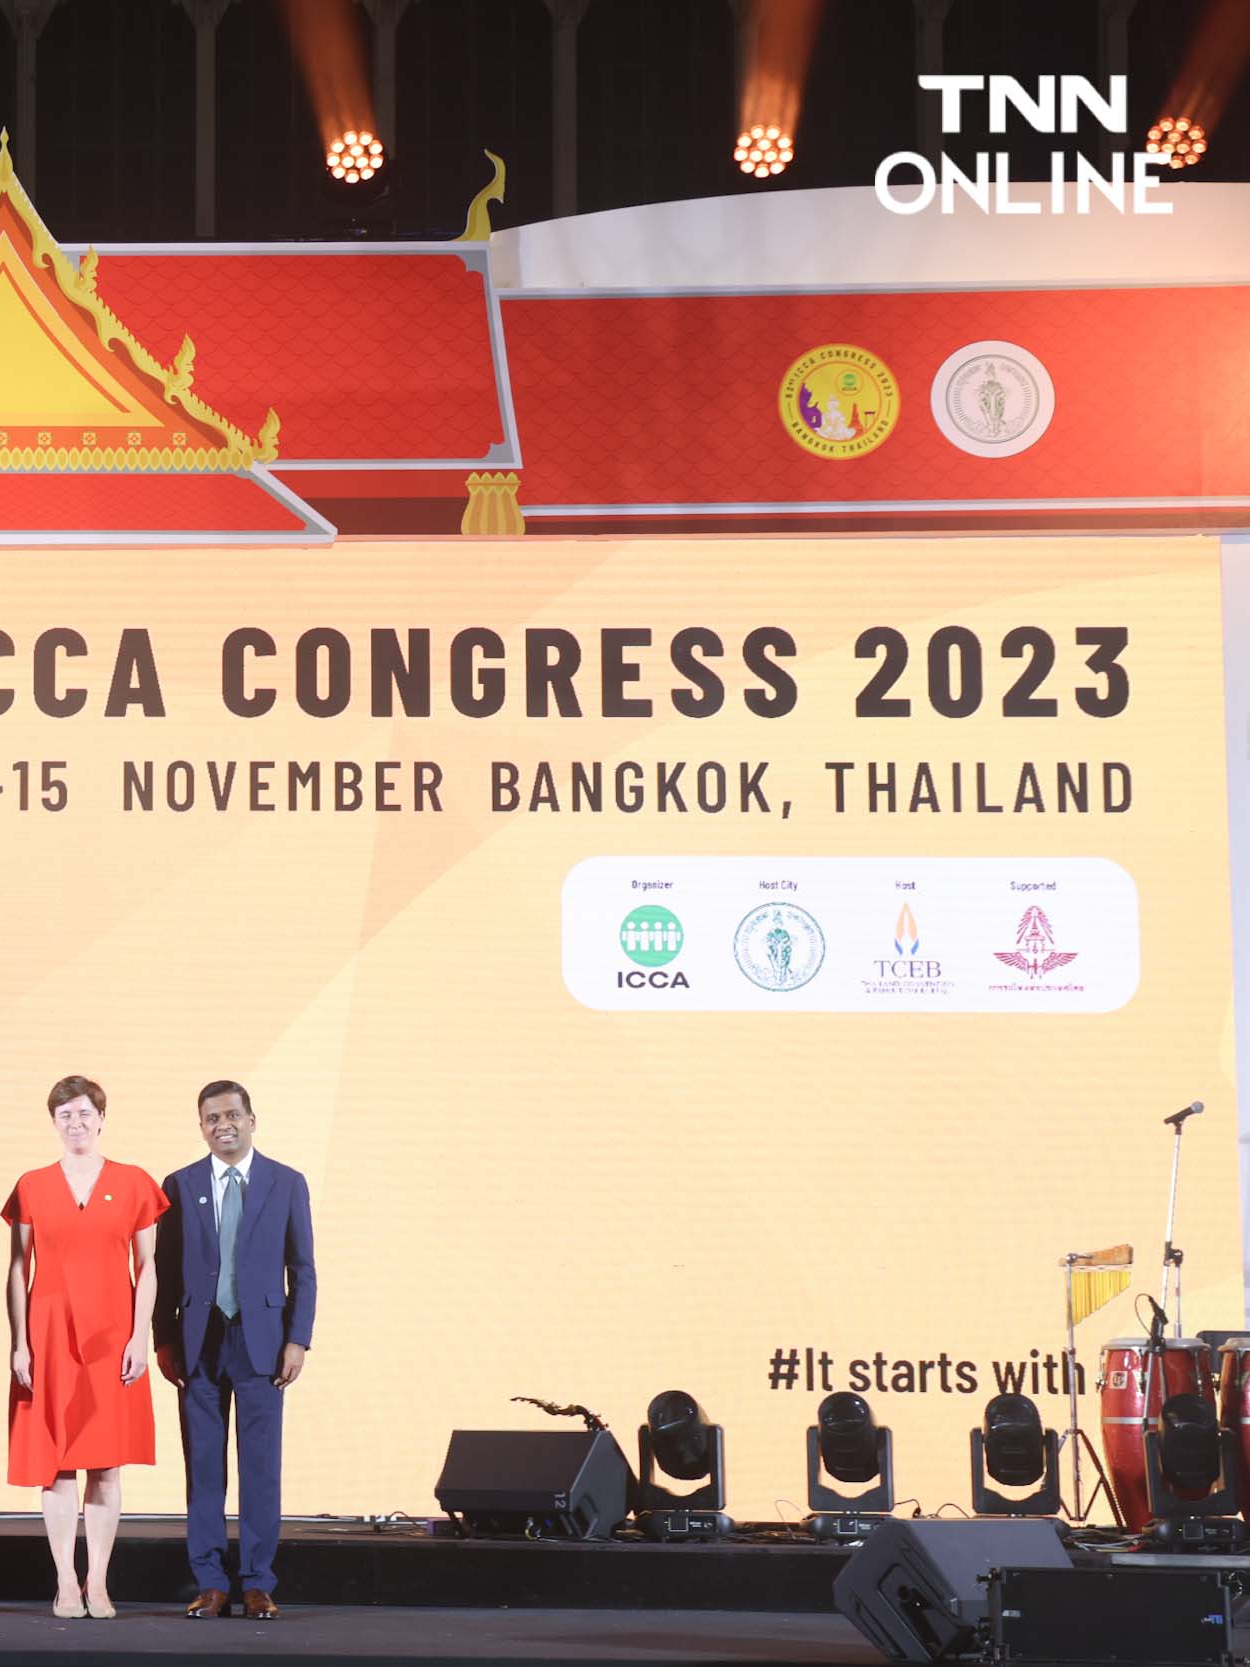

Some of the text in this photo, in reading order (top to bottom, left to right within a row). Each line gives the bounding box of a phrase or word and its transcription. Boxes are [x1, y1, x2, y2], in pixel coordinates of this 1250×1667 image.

[819, 349, 877, 370] CONGRESS
[791, 419, 890, 453] BANGKOK THAILAND
[222, 627, 798, 718] CONGRESS
[854, 626, 1130, 718] 2023
[123, 761, 443, 812] NOVEMBER
[491, 761, 792, 819] BANGKOK,
[825, 762, 1132, 813] THAILAND
[631, 880, 674, 892] Organizer
[759, 880, 798, 891] Host City
[895, 881, 916, 891] Host
[1009, 881, 1057, 892] Supported
[873, 960, 942, 979] TCEB
[617, 971, 690, 989] ICCA
[768, 1347, 1086, 1395] #It starts with
[553, 1491, 567, 1509] 12
